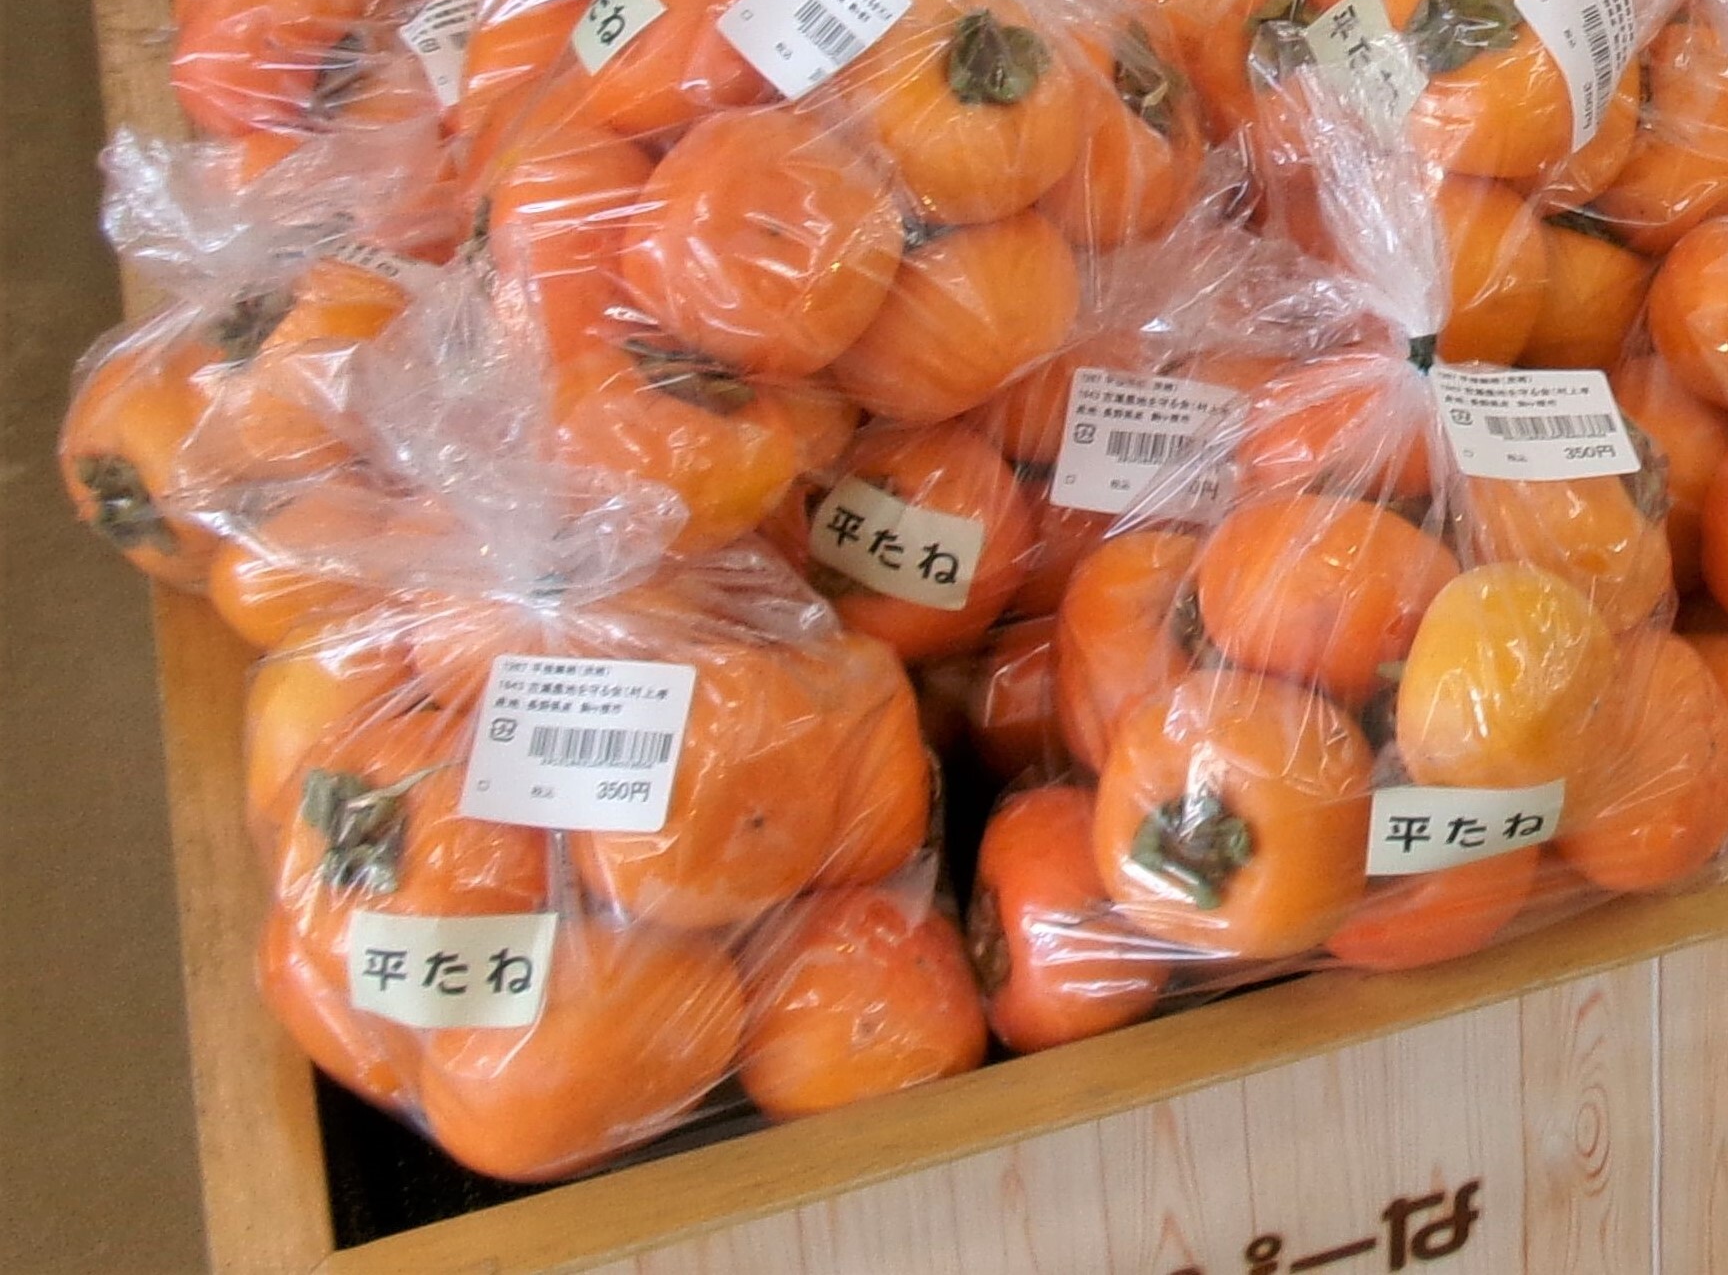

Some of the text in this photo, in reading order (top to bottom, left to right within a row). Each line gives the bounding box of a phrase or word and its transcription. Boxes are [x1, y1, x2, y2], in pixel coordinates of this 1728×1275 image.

[1564, 444, 1617, 461] 350円
[826, 505, 960, 585] 平たね
[596, 780, 653, 803] 350円
[1385, 812, 1545, 854] 平たね
[362, 947, 533, 995] 平たね
